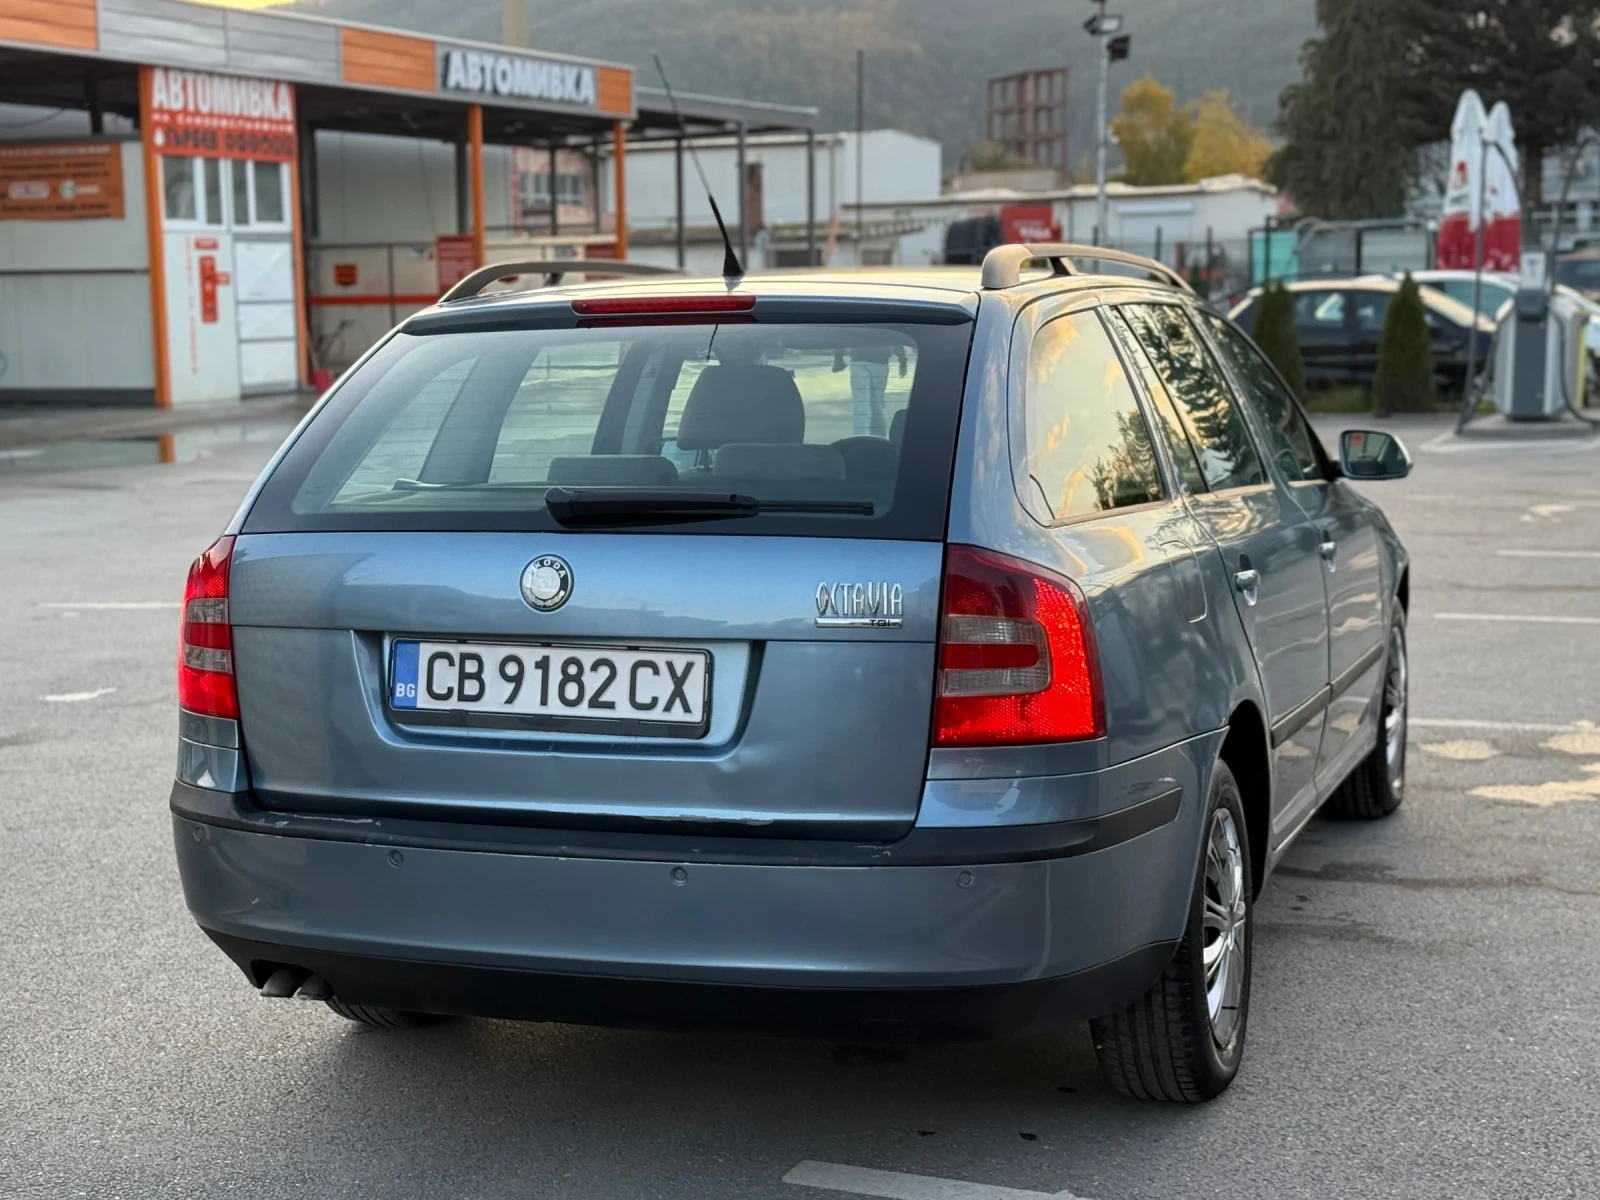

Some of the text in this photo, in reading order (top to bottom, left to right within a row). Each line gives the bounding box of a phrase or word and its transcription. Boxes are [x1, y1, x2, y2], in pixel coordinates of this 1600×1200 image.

[152, 68, 293, 121] АВТОМИВКА
[447, 50, 595, 106] АВТОМИВКА
[815, 581, 903, 616] OCTAVIA
[869, 619, 891, 627] TDI
[395, 682, 416, 698] BG
